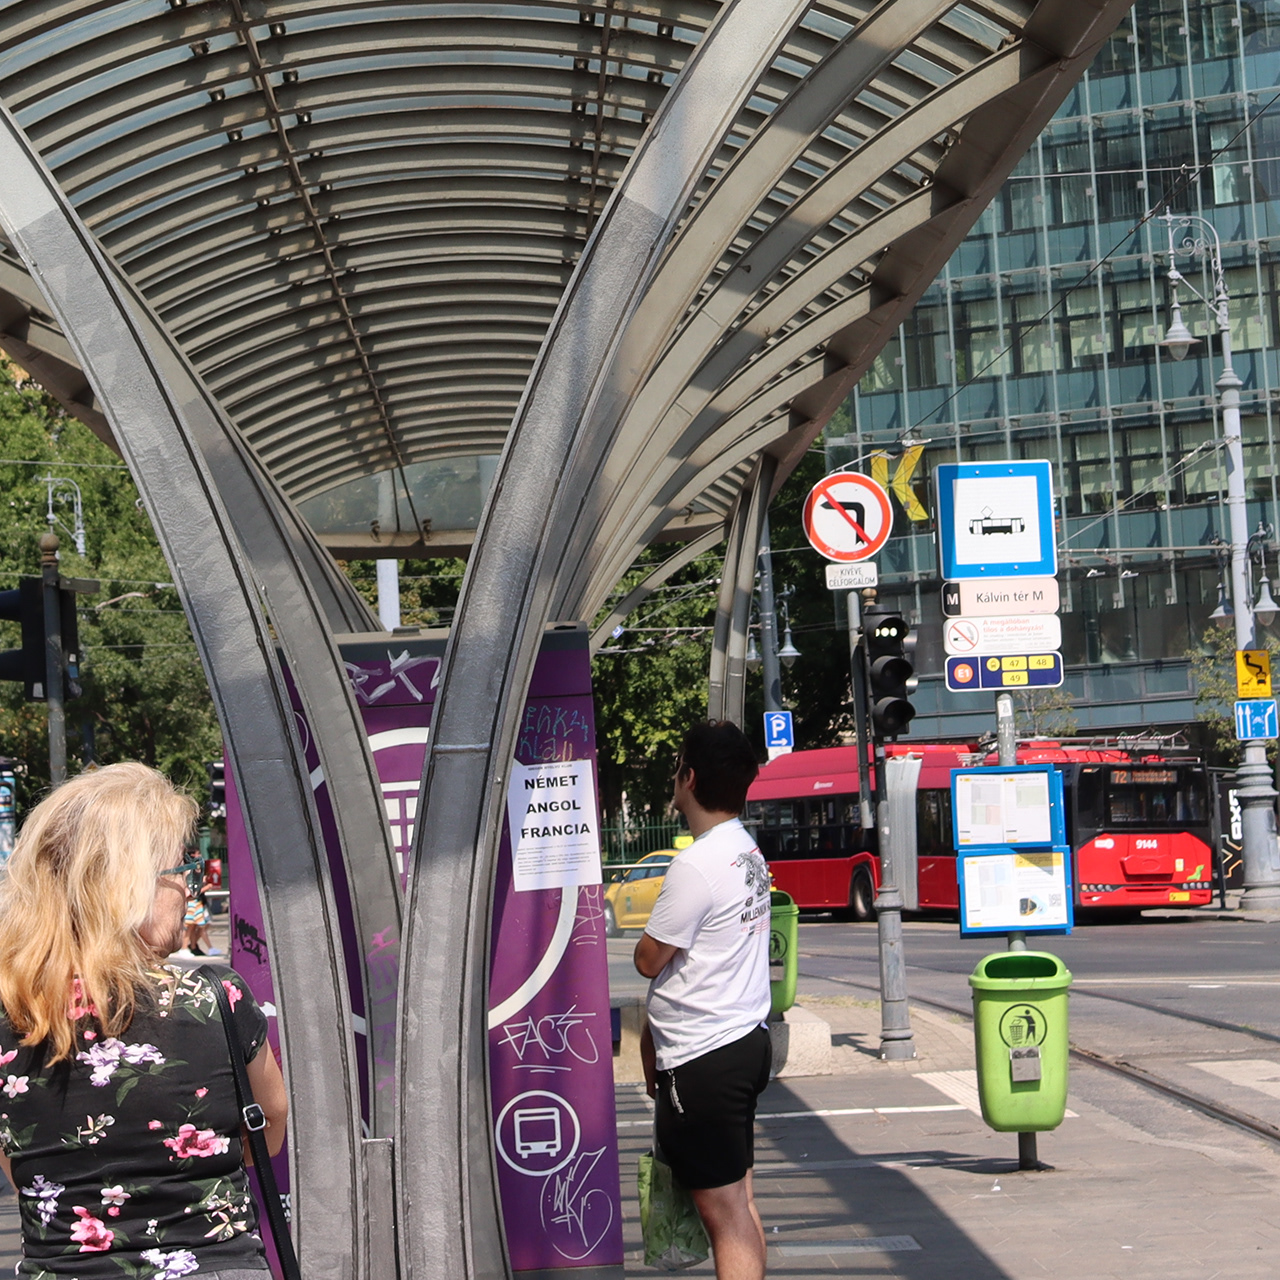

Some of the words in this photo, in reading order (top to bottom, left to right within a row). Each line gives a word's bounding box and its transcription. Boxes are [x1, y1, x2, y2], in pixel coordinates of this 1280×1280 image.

[840, 565, 862, 576] KIVÉVE
[946, 593, 959, 605] M
[976, 591, 1010, 604] Kálvin
[1013, 590, 1029, 602] tér
[1032, 590, 1043, 601] M
[957, 668, 970, 678] E1
[1009, 674, 1021, 682] 49
[771, 719, 786, 738] P
[524, 774, 579, 790] NÉMET
[1113, 770, 1128, 784] 72
[526, 799, 582, 815] ANGOL
[521, 823, 591, 839] FRANCIA
[1135, 839, 1158, 850] 9144
